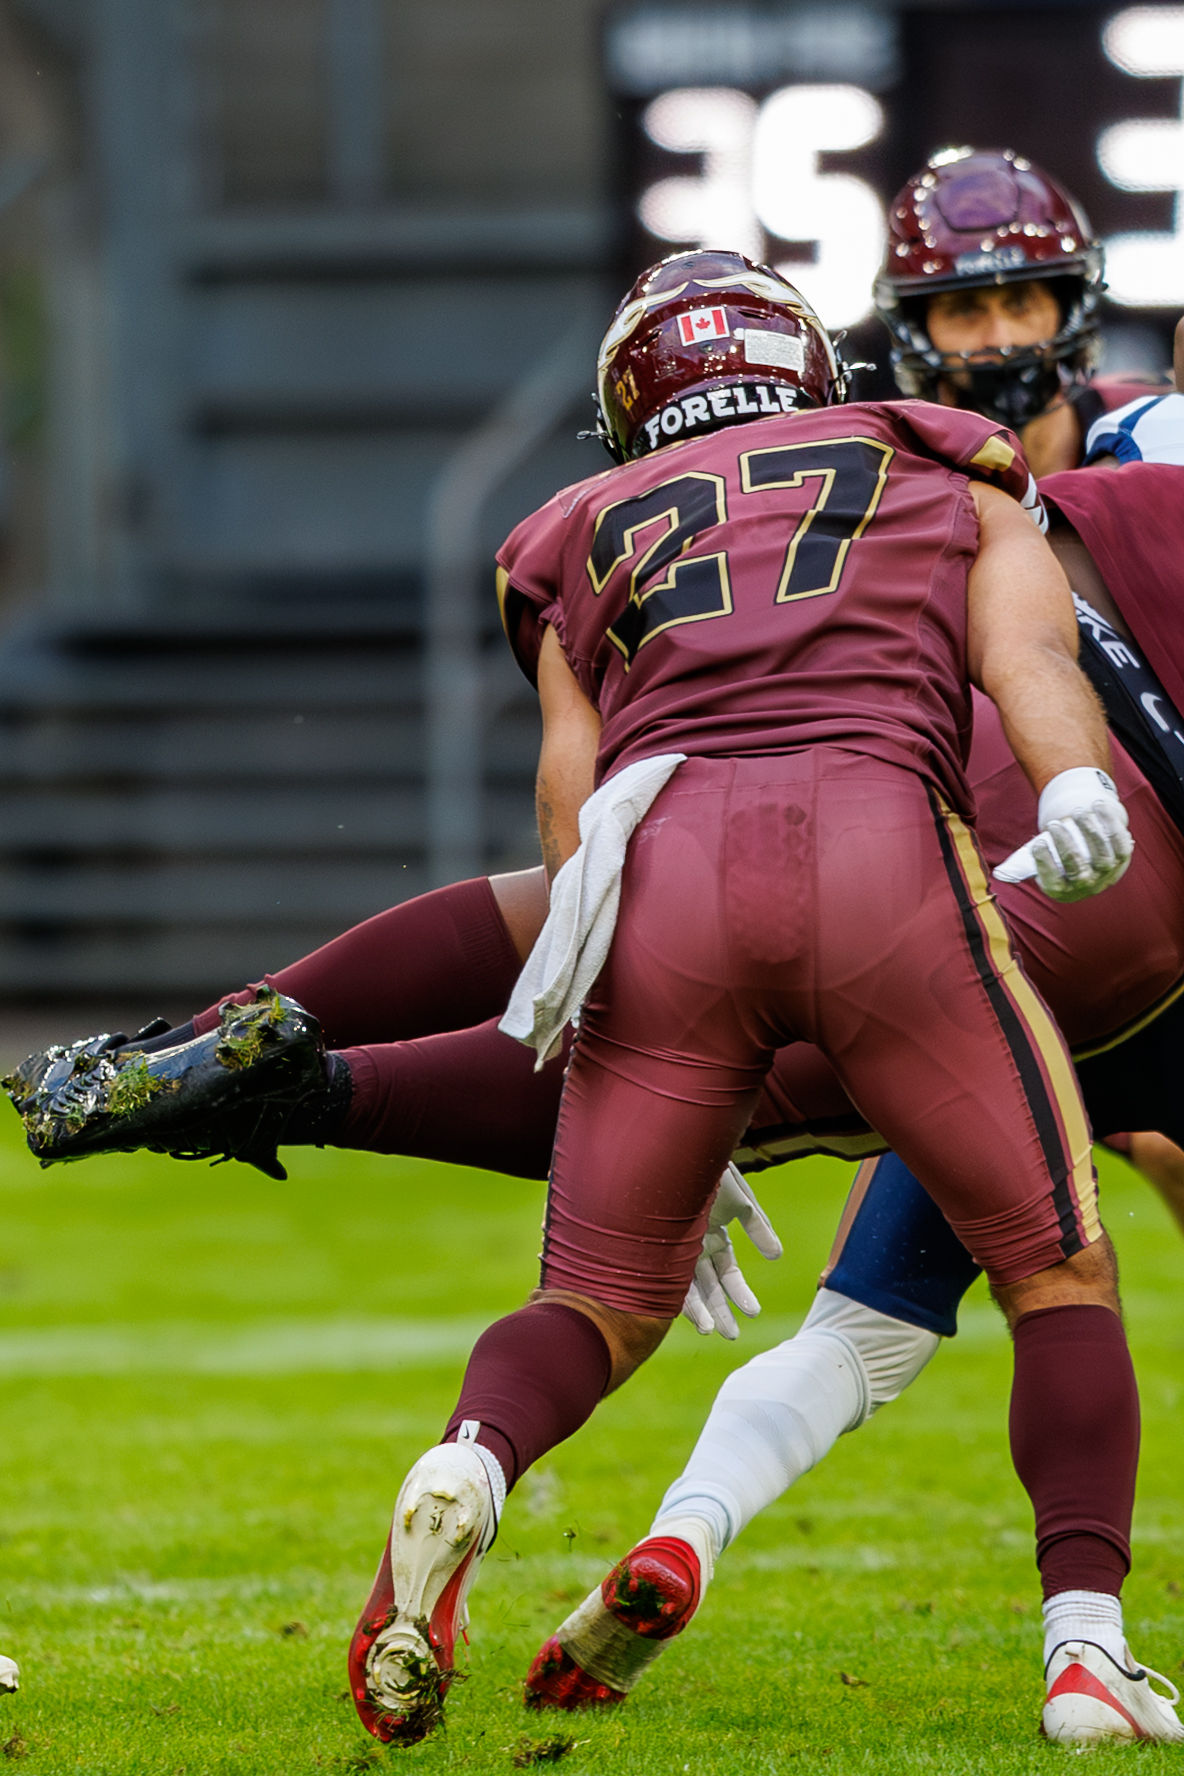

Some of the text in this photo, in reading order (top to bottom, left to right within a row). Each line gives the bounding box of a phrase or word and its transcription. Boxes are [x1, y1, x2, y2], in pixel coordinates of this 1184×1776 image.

[638, 84, 889, 329] 35
[616, 365, 641, 411] 27
[645, 386, 799, 449] FORELLE
[586, 436, 895, 674] 27
